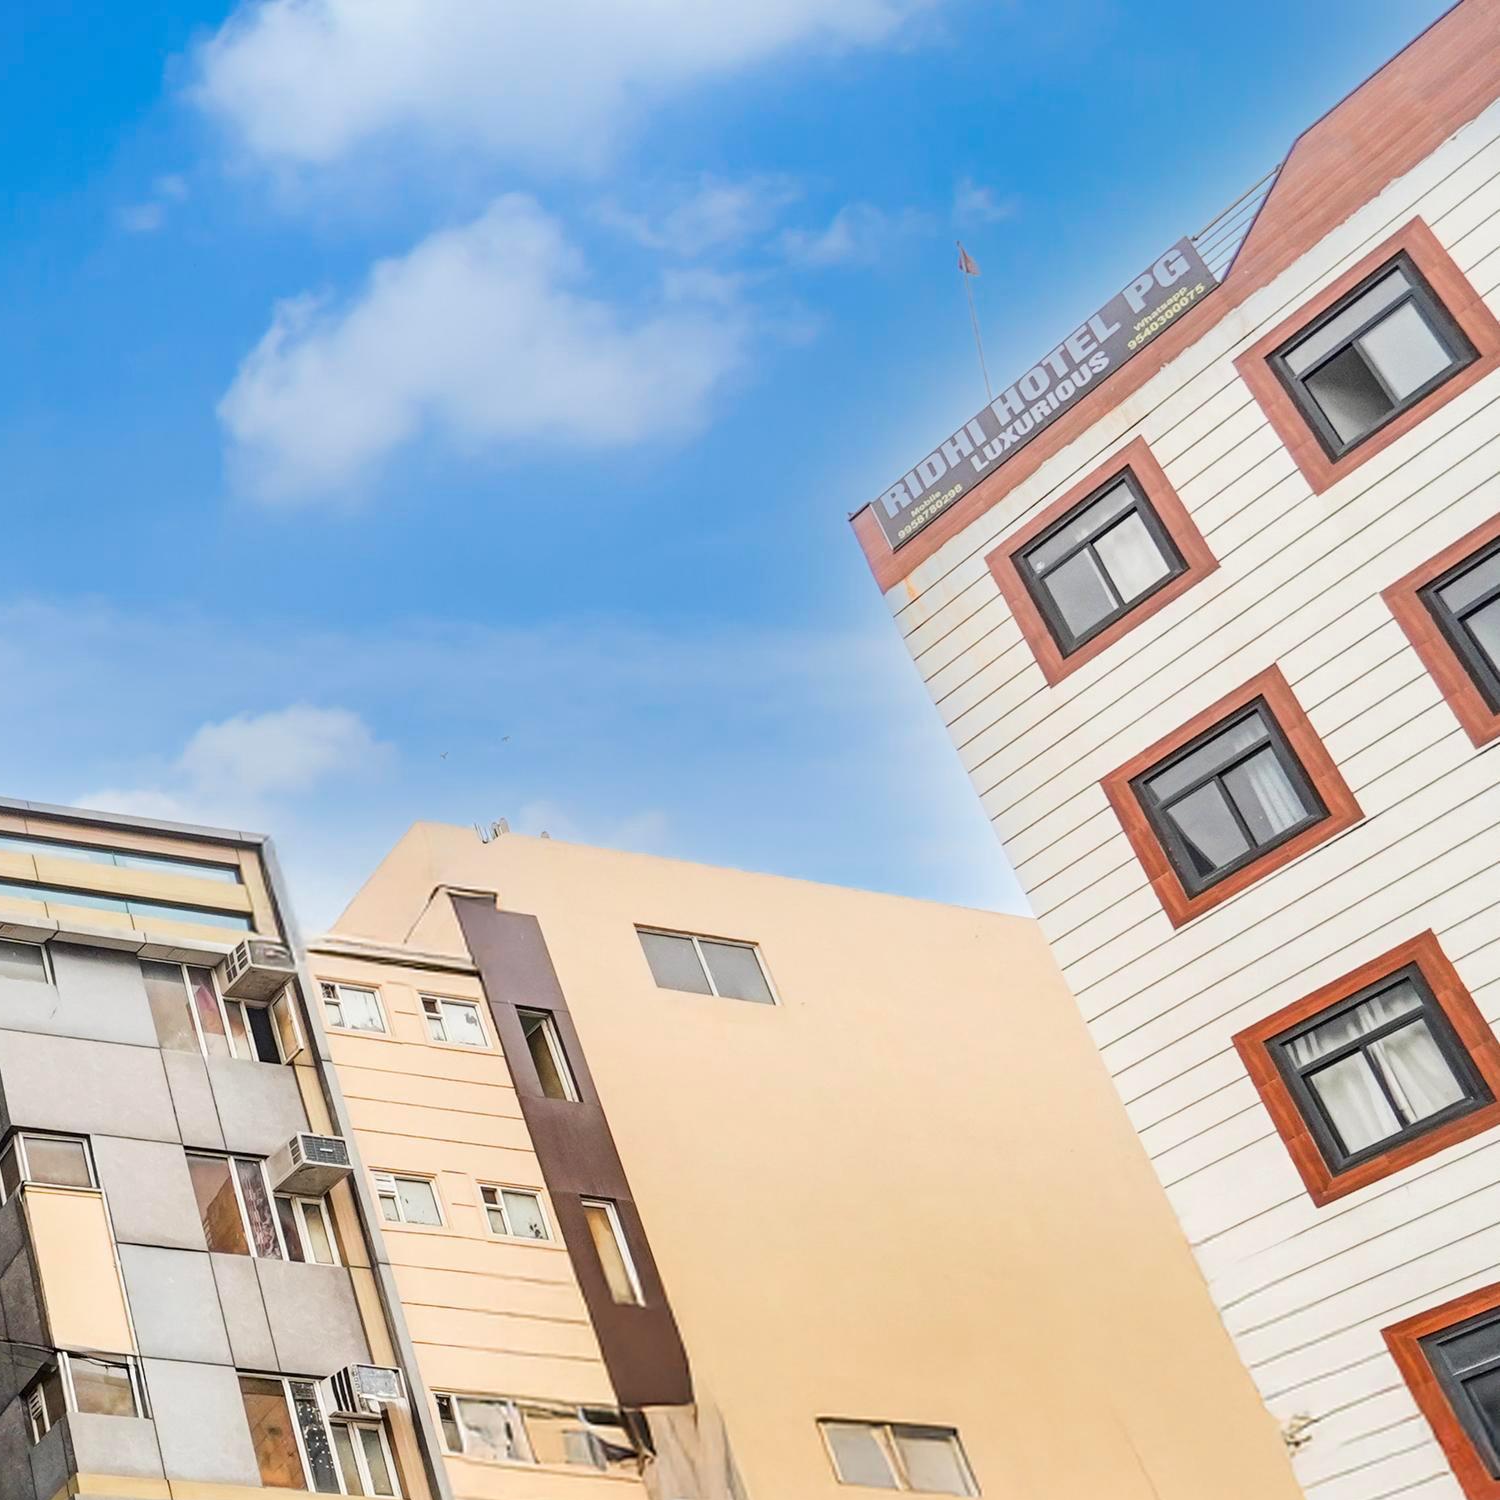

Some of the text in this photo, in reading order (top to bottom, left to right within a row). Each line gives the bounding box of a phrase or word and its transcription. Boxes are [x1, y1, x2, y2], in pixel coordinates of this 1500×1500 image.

[1133, 287, 1187, 331] Whatsapp
[880, 249, 1191, 519] RIDHI HOTEL PG
[970, 350, 1110, 472] LUXURIOUS
[910, 491, 941, 517] Mobile
